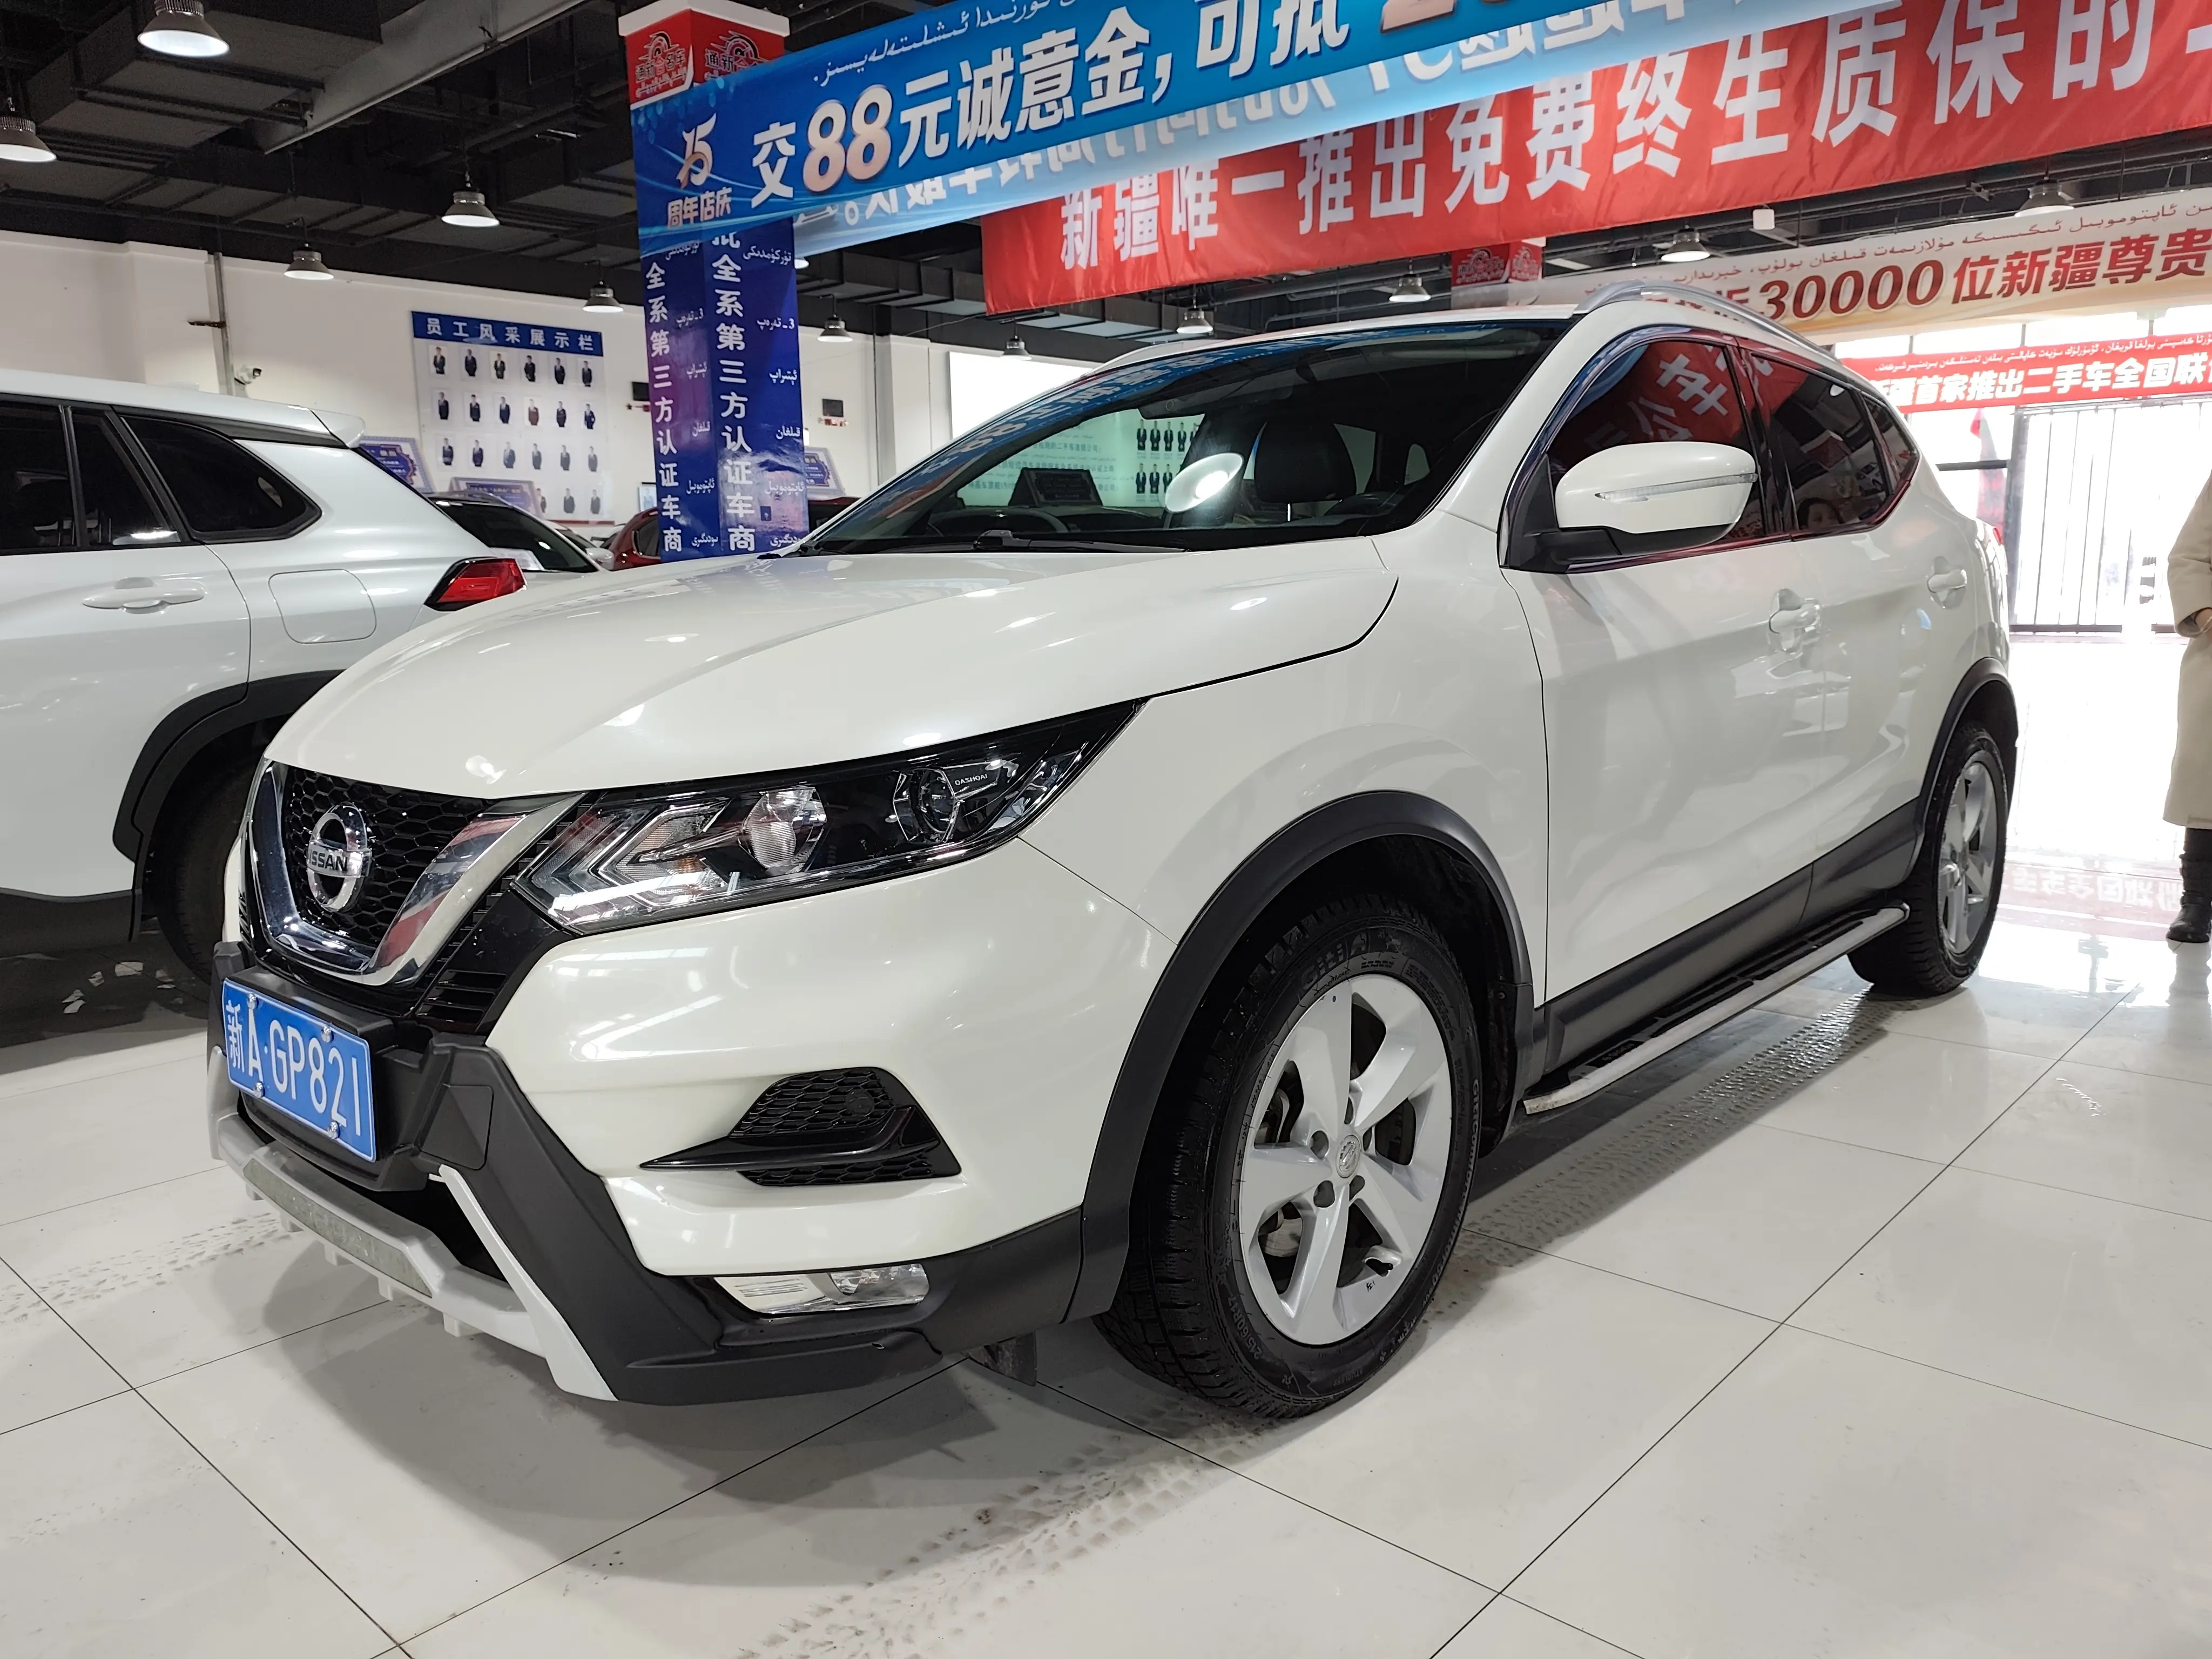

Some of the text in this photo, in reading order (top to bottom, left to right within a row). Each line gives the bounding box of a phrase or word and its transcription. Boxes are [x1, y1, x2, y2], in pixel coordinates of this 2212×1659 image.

[667, 186, 732, 229] 周年店庆
[427, 318, 594, 352] 员工风采展示栏
[645, 261, 683, 552] 全系第三方认证车商
[954, 773, 988, 786] QASHQAI
